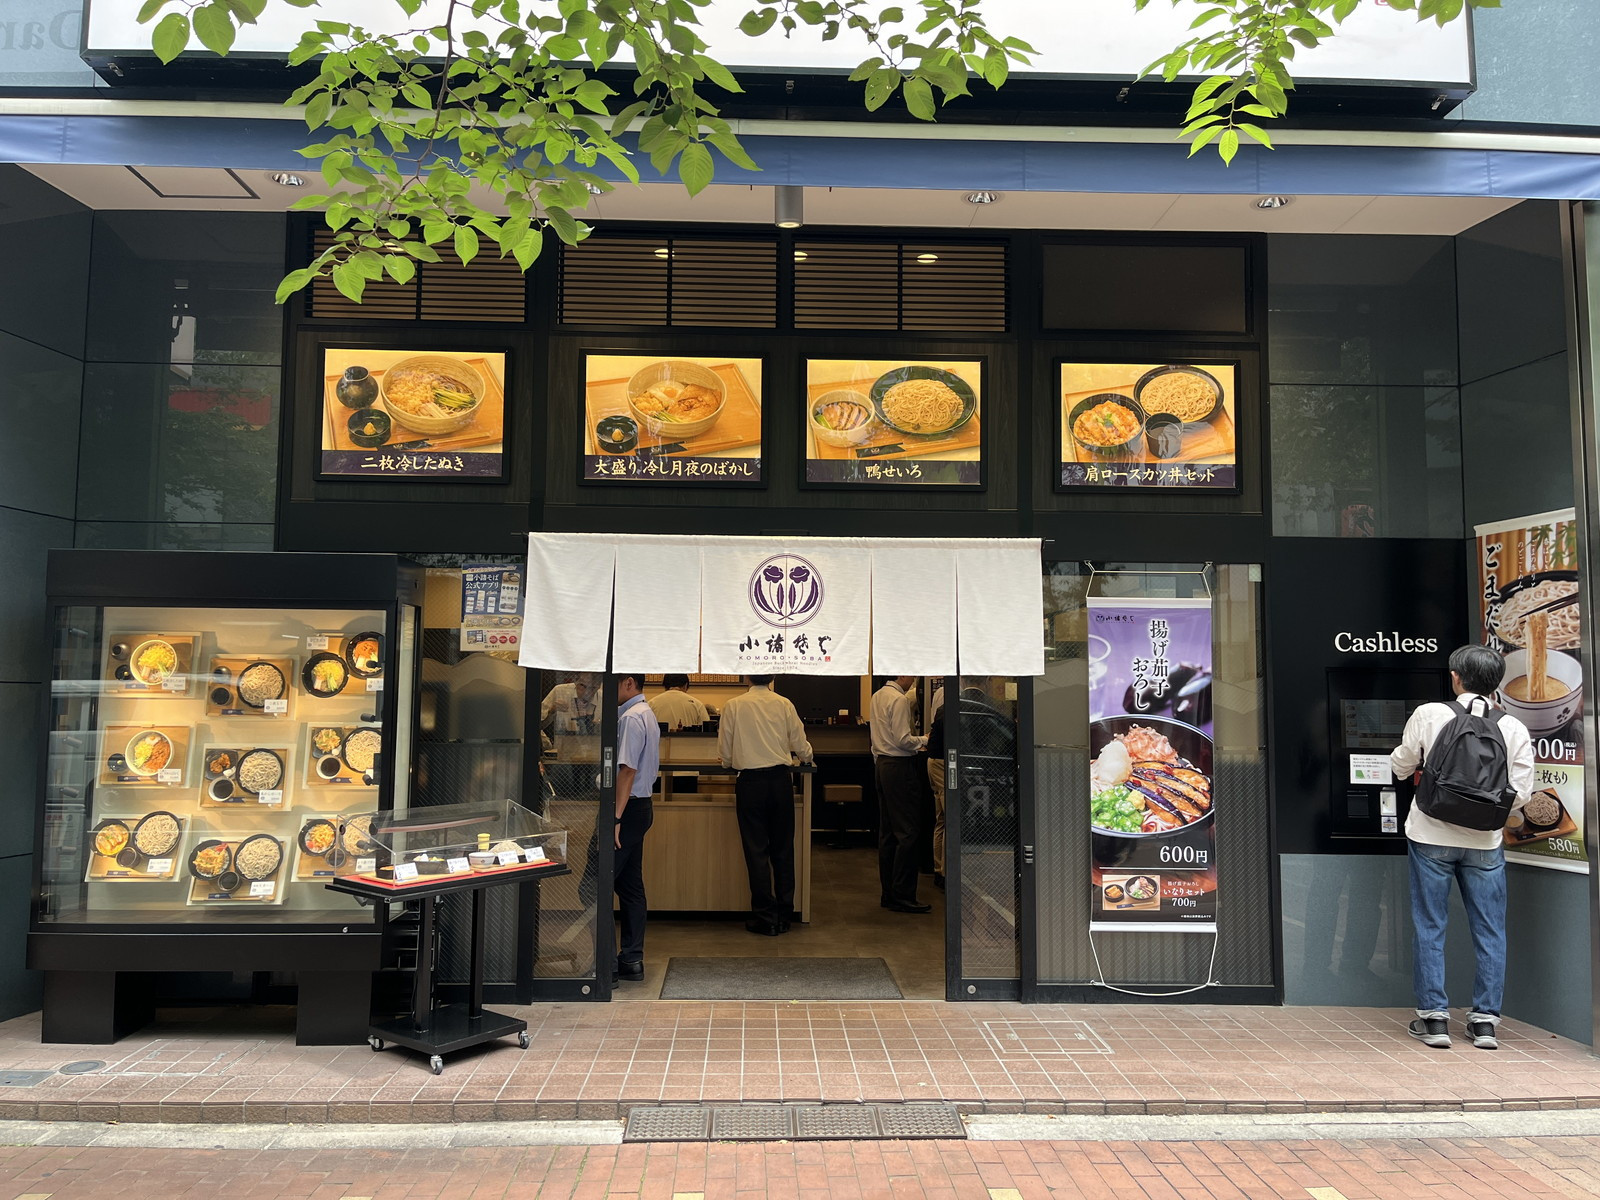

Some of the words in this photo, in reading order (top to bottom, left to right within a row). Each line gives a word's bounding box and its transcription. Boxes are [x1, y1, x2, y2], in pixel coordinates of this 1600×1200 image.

[360, 454, 465, 472] 二枚冷したぬき
[865, 463, 923, 479] 鴨せいろ
[1084, 465, 1215, 484] 肩ロースカツ丼セット
[465, 582, 500, 590] 公式アプリ
[1334, 631, 1439, 653] Cashless
[1149, 619, 1170, 698] 揚げ茄子
[1132, 657, 1151, 710] おろし
[1159, 845, 1208, 864] 600円
[1548, 837, 1580, 854] 580円
[1163, 887, 1205, 897] いなりセット
[1171, 897, 1197, 908] 700円
